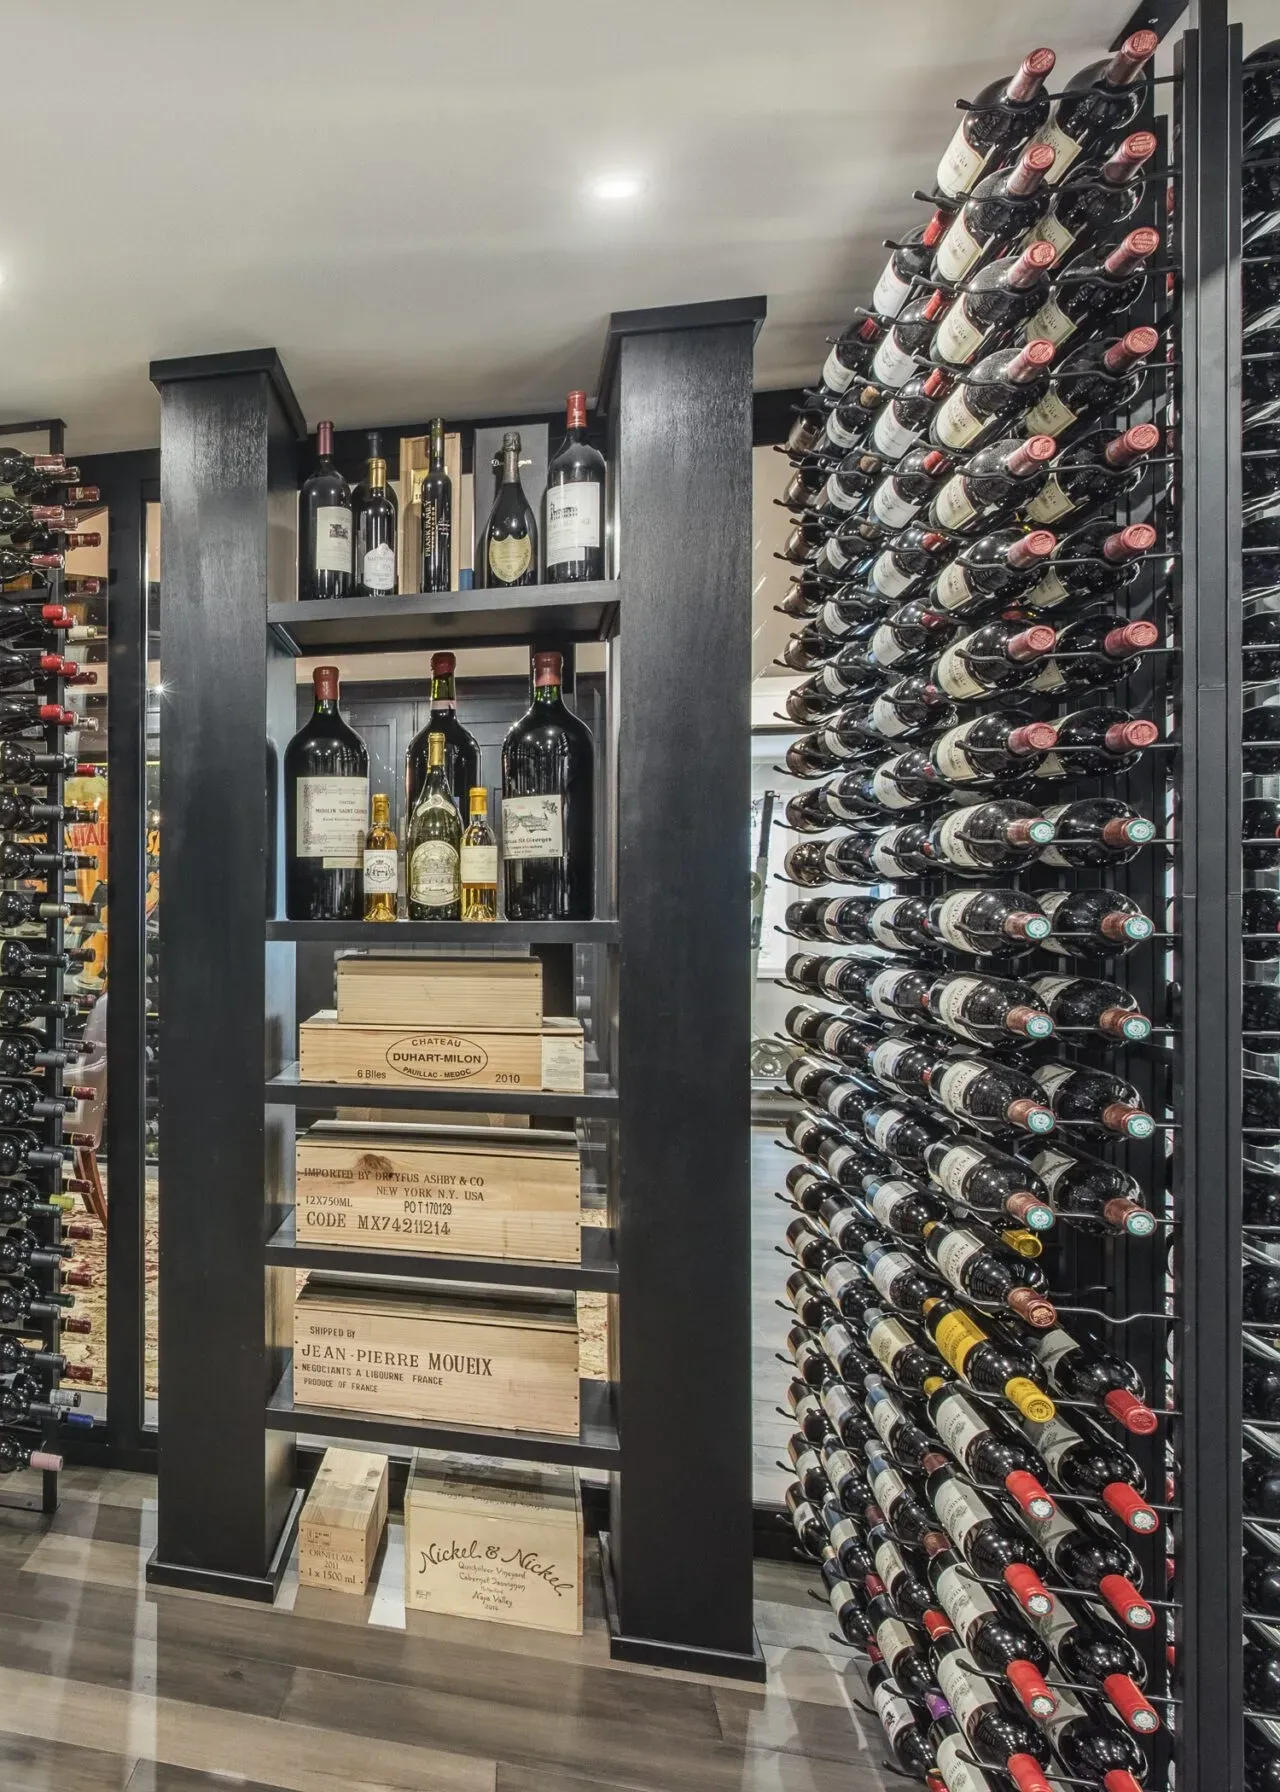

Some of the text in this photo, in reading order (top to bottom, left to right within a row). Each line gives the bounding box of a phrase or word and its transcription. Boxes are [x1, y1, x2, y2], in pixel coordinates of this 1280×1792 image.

[411, 1037, 462, 1048] CHATEAU
[393, 1053, 481, 1065] DUHART-MILON
[357, 1069, 364, 1079] 6
[402, 1066, 472, 1079] PAUILLAC MEDOC
[495, 1073, 521, 1084] 2010
[304, 1167, 484, 1187] IMPORTED BY DREYFUS ASHBY & CO
[376, 1185, 485, 1202] NEW YORK N.Y. USA
[425, 1203, 452, 1216] 170129
[306, 1211, 346, 1228] CODE
[309, 1325, 356, 1339] SHIPPED BY
[428, 1352, 493, 1377] MOUEIX
[303, 1377, 379, 1393] PRODUCE OF FRANCE
[356, 1369, 362, 1377] A
[365, 1370, 405, 1382] LIBOURNE
[412, 1374, 444, 1386] FRANCE
[322, 1569, 344, 1582] 1500
[345, 1573, 357, 1585] ml
[418, 1540, 575, 1598] Nickel & Nickel
[471, 1590, 513, 1609] Napa Valley
